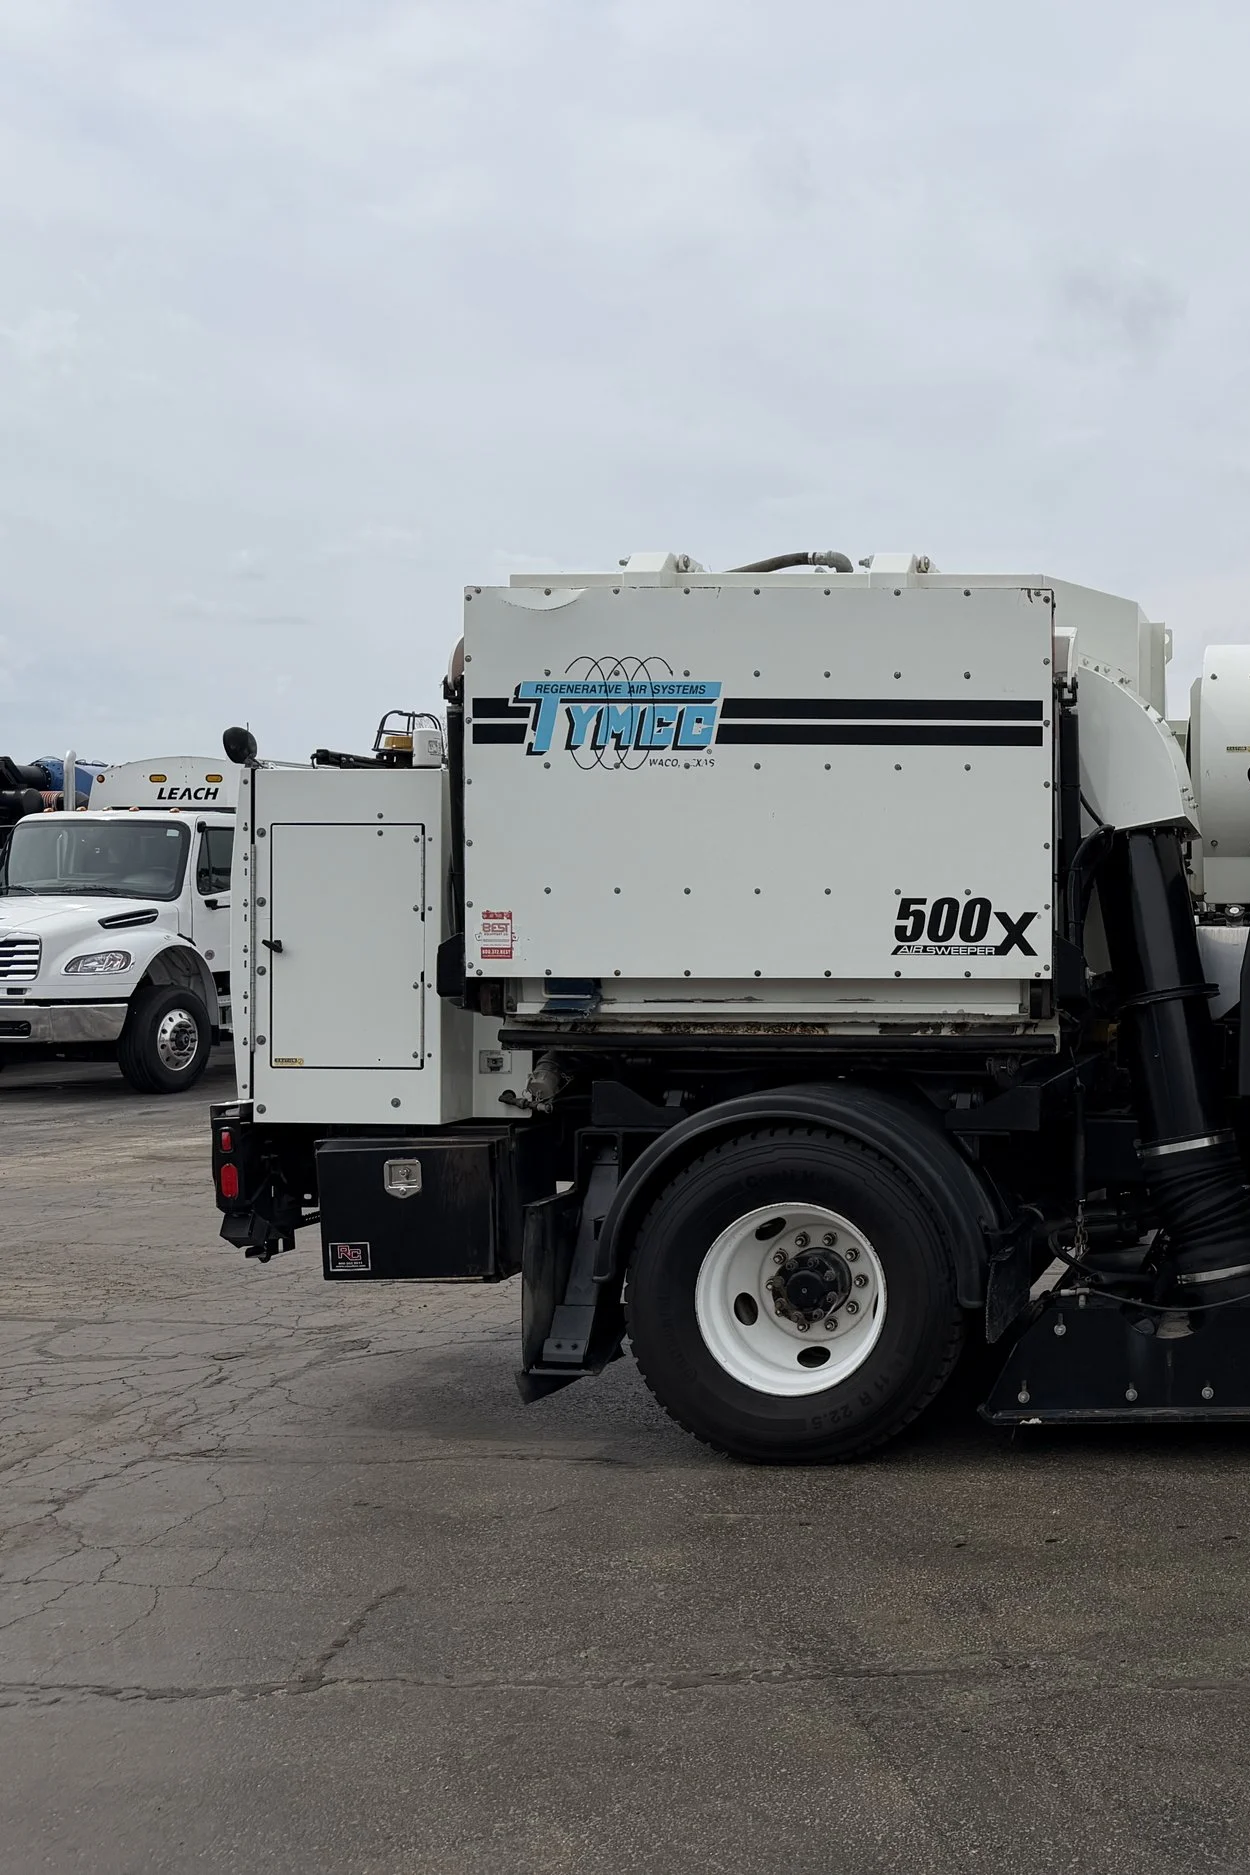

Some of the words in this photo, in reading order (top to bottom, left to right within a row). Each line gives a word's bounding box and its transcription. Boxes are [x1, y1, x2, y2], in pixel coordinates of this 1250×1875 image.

[535, 683, 622, 695] REGENERATIVE
[628, 684, 647, 695] AIR
[653, 683, 707, 695] SYSTEMS
[649, 758, 681, 768] WACO,
[684, 758, 716, 768] EXAS
[157, 787, 220, 801] LEACH
[897, 945, 924, 955] AIR
[926, 945, 996, 955] SWEEPER
